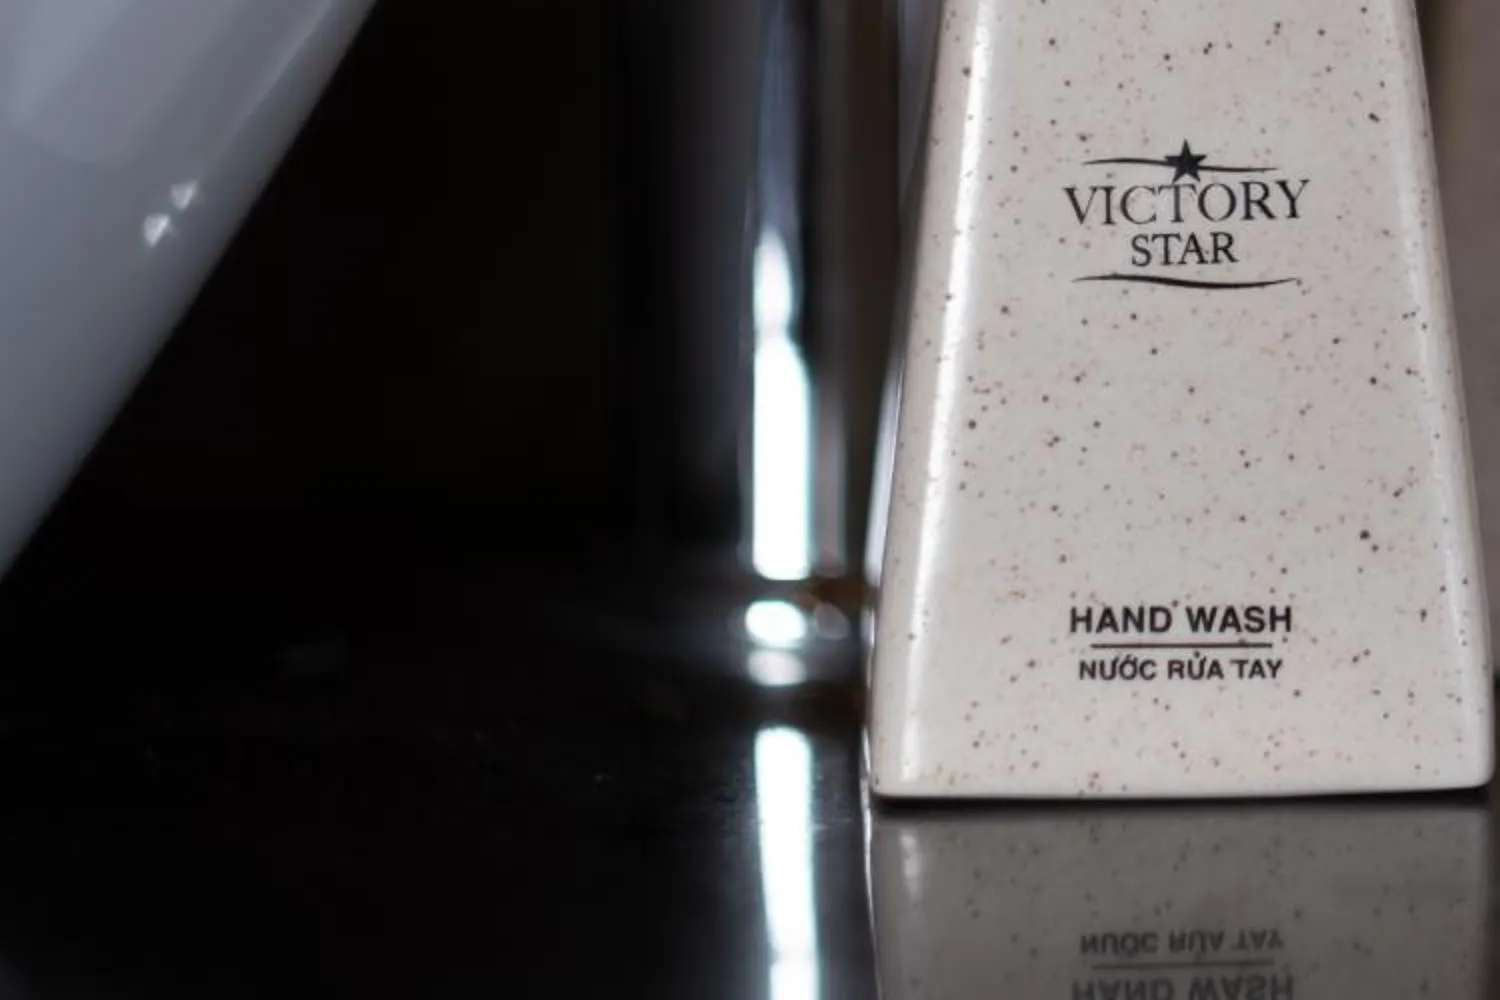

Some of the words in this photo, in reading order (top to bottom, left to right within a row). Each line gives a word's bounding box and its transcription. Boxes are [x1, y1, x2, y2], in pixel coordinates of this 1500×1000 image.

[1063, 178, 1310, 226] VICTORY
[1131, 231, 1239, 267] STAR
[1070, 606, 1173, 634] HAND
[1185, 606, 1293, 634] WASH
[1079, 653, 1157, 681] NƯỚC
[1167, 650, 1225, 681] RỬA
[1230, 659, 1284, 681] TAY
